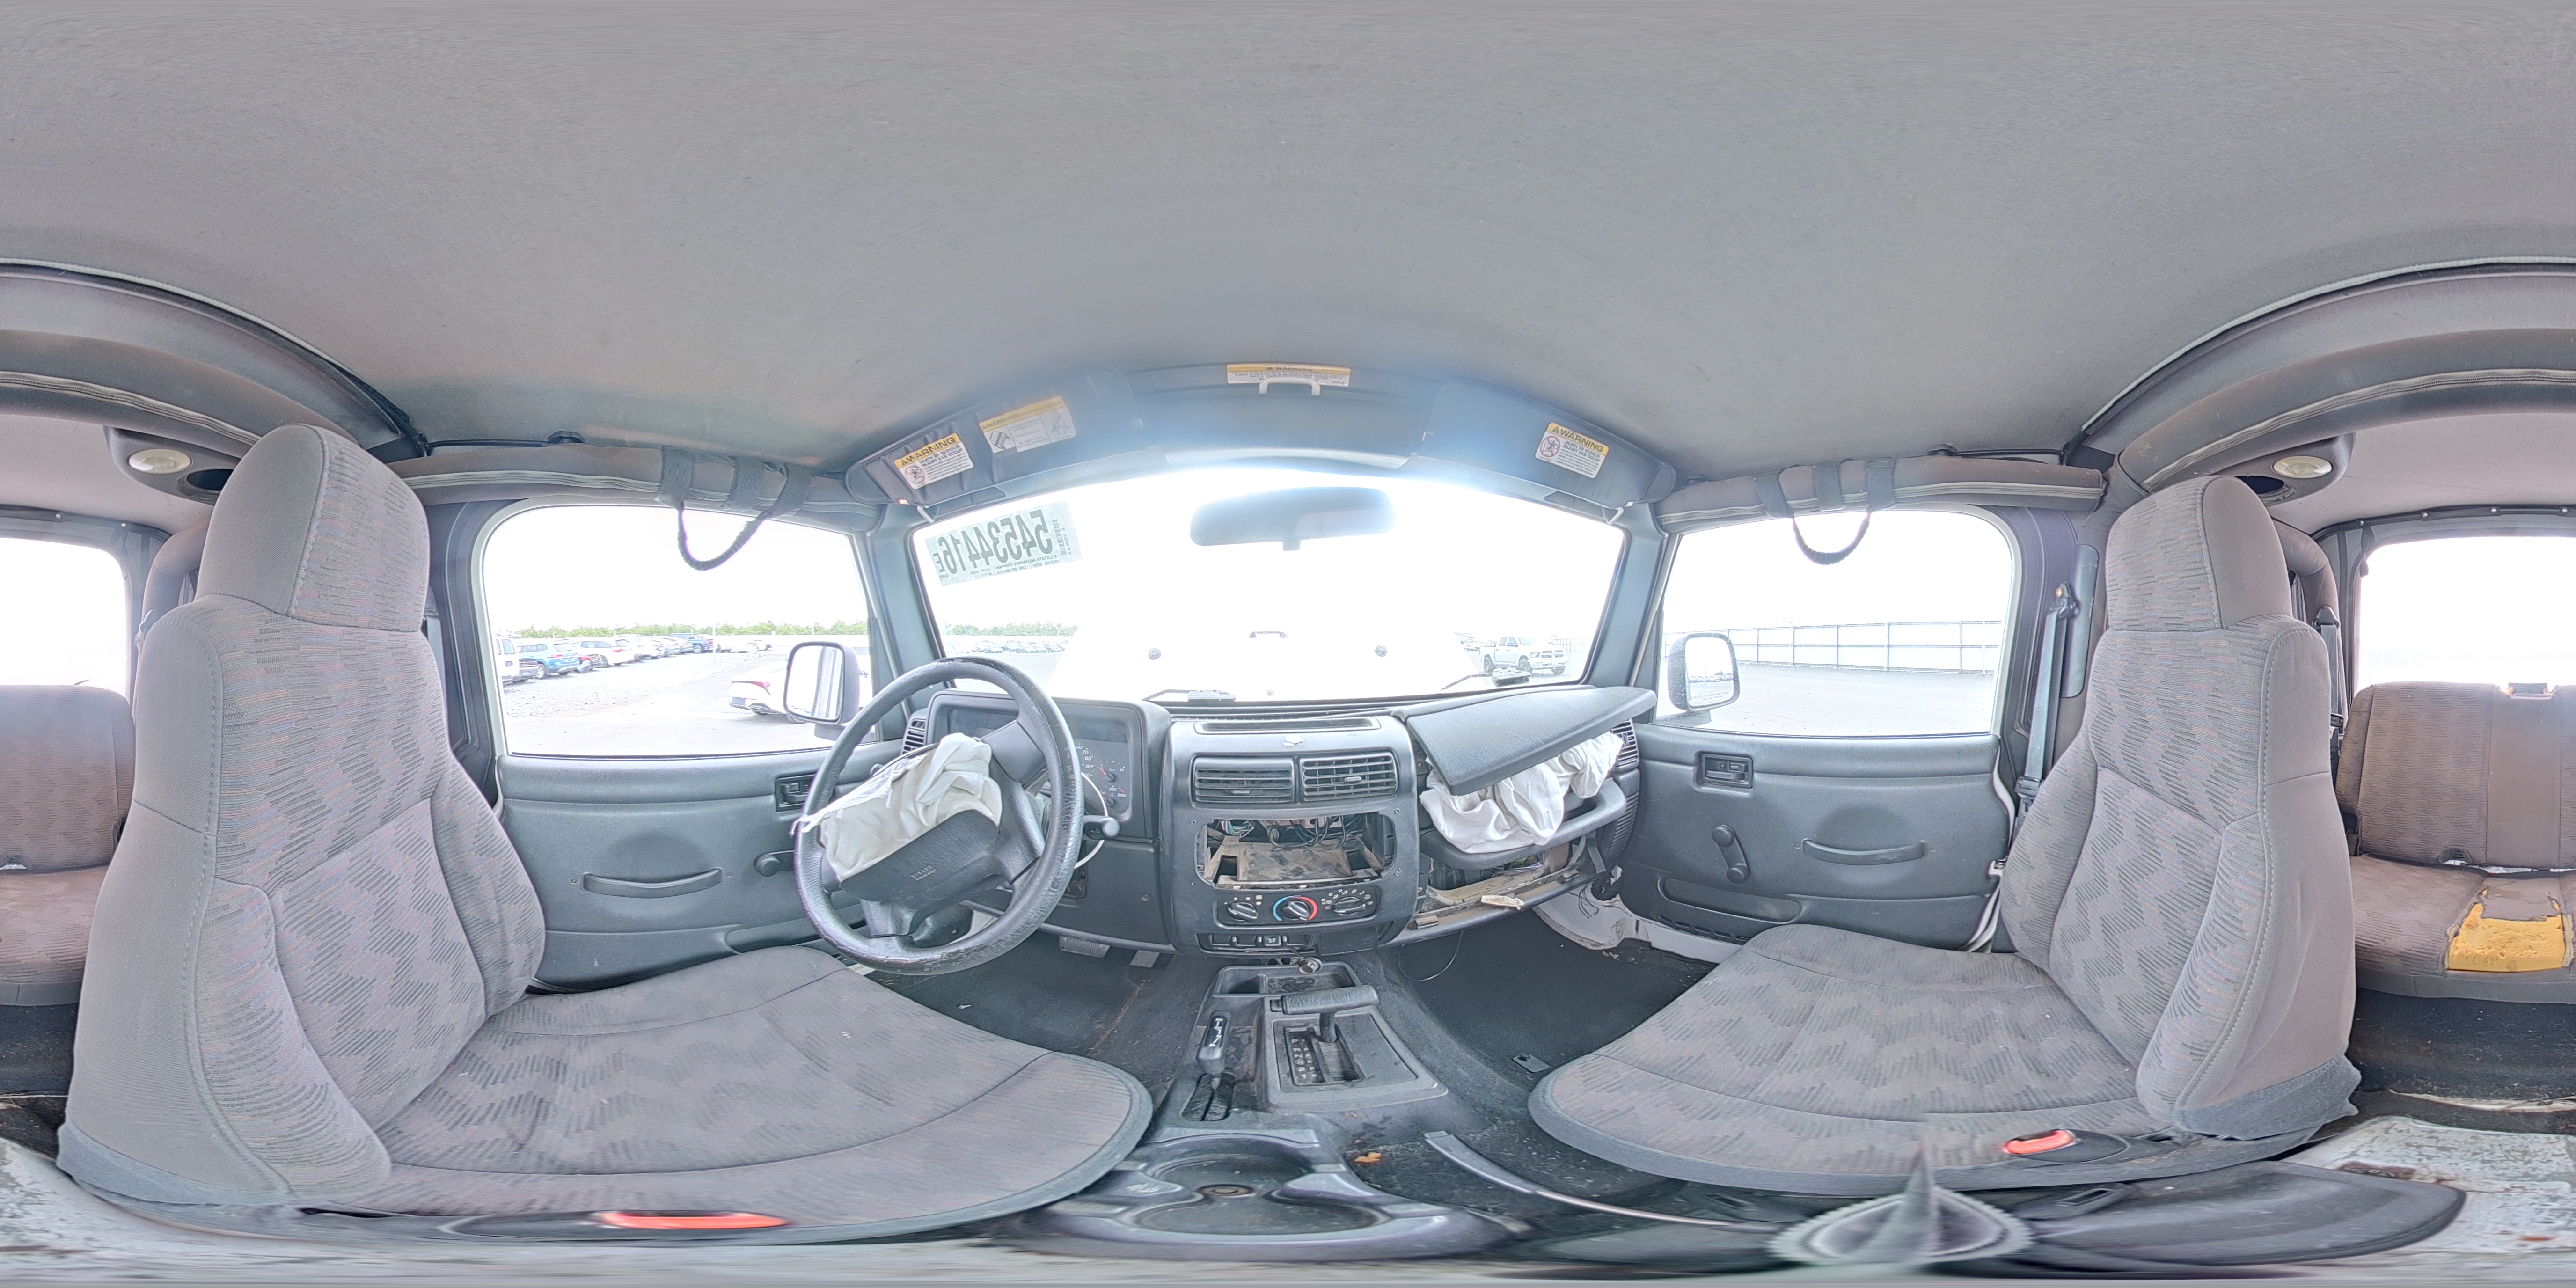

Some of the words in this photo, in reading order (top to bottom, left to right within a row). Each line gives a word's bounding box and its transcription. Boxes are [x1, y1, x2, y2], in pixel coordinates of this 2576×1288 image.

[986, 414, 1019, 428] WARNING
[906, 437, 956, 461] WARNING
[1560, 428, 1604, 453] WARNING
[1563, 445, 1578, 453] INJURY
[1565, 440, 1578, 449] DEATH
[1585, 449, 1600, 458] SERIOUS
[919, 456, 934, 464] DEATH
[940, 444, 960, 455] SERIOUS
[922, 458, 937, 467] INJURY
[948, 448, 963, 457] OCCUR
